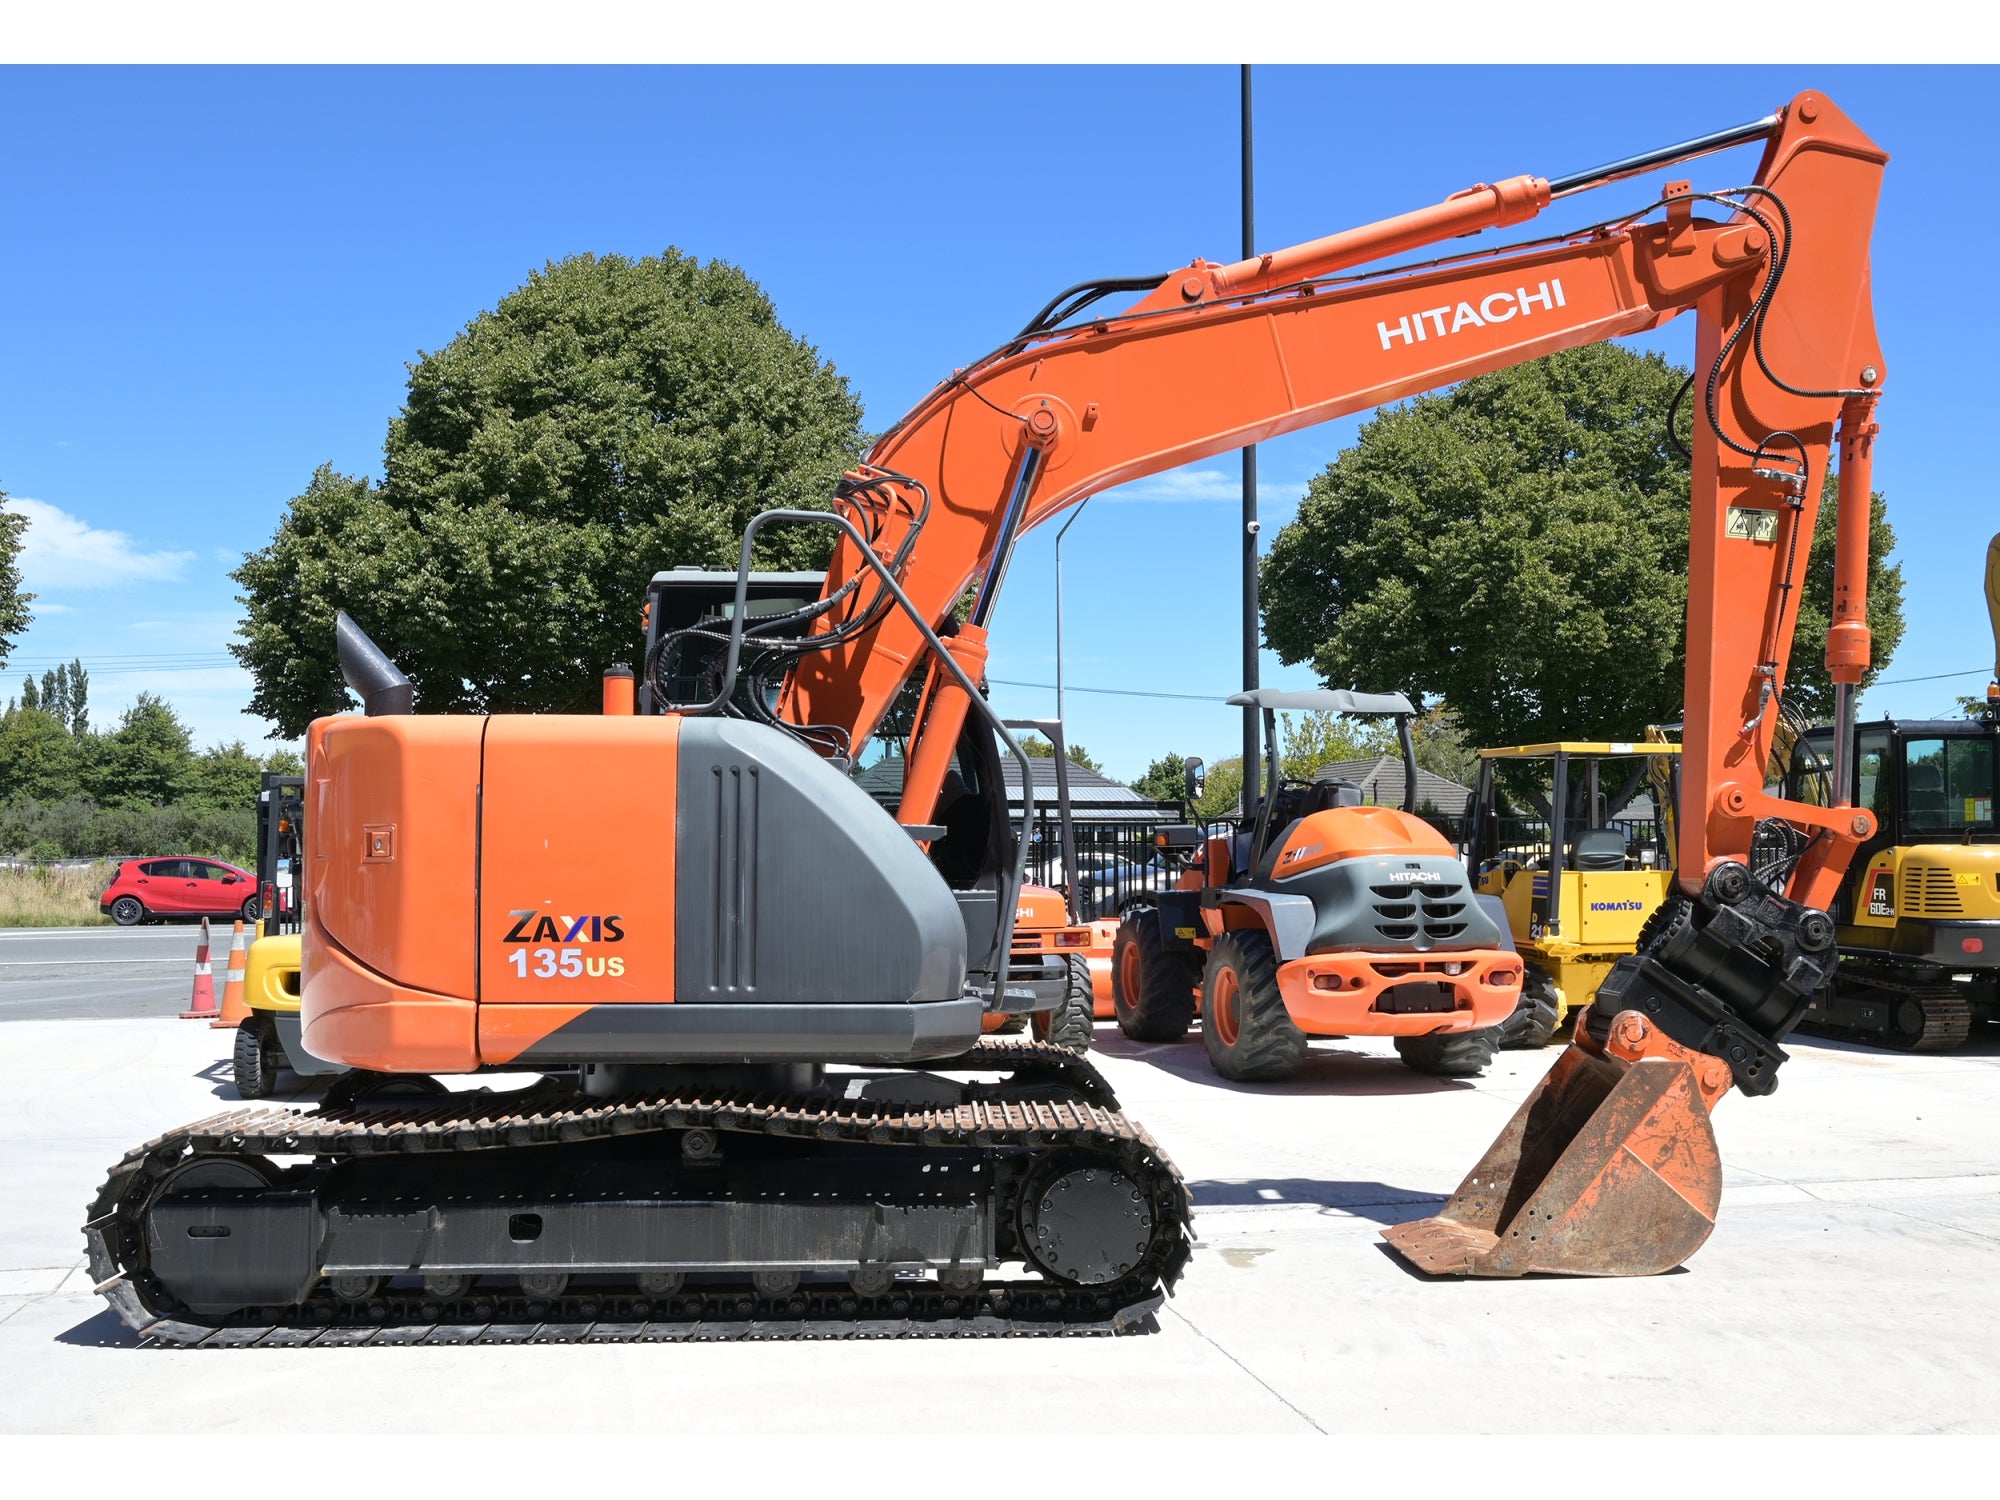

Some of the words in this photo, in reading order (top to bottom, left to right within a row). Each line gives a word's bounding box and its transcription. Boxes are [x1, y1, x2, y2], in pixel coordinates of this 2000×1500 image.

[1376, 278, 1566, 351] HITACHI
[1389, 872, 1441, 882] HITACHI
[1873, 888, 1886, 900] FR
[1590, 899, 1643, 911] KOMATSU
[1531, 912, 1538, 923] D
[502, 909, 625, 943] ZAXIS
